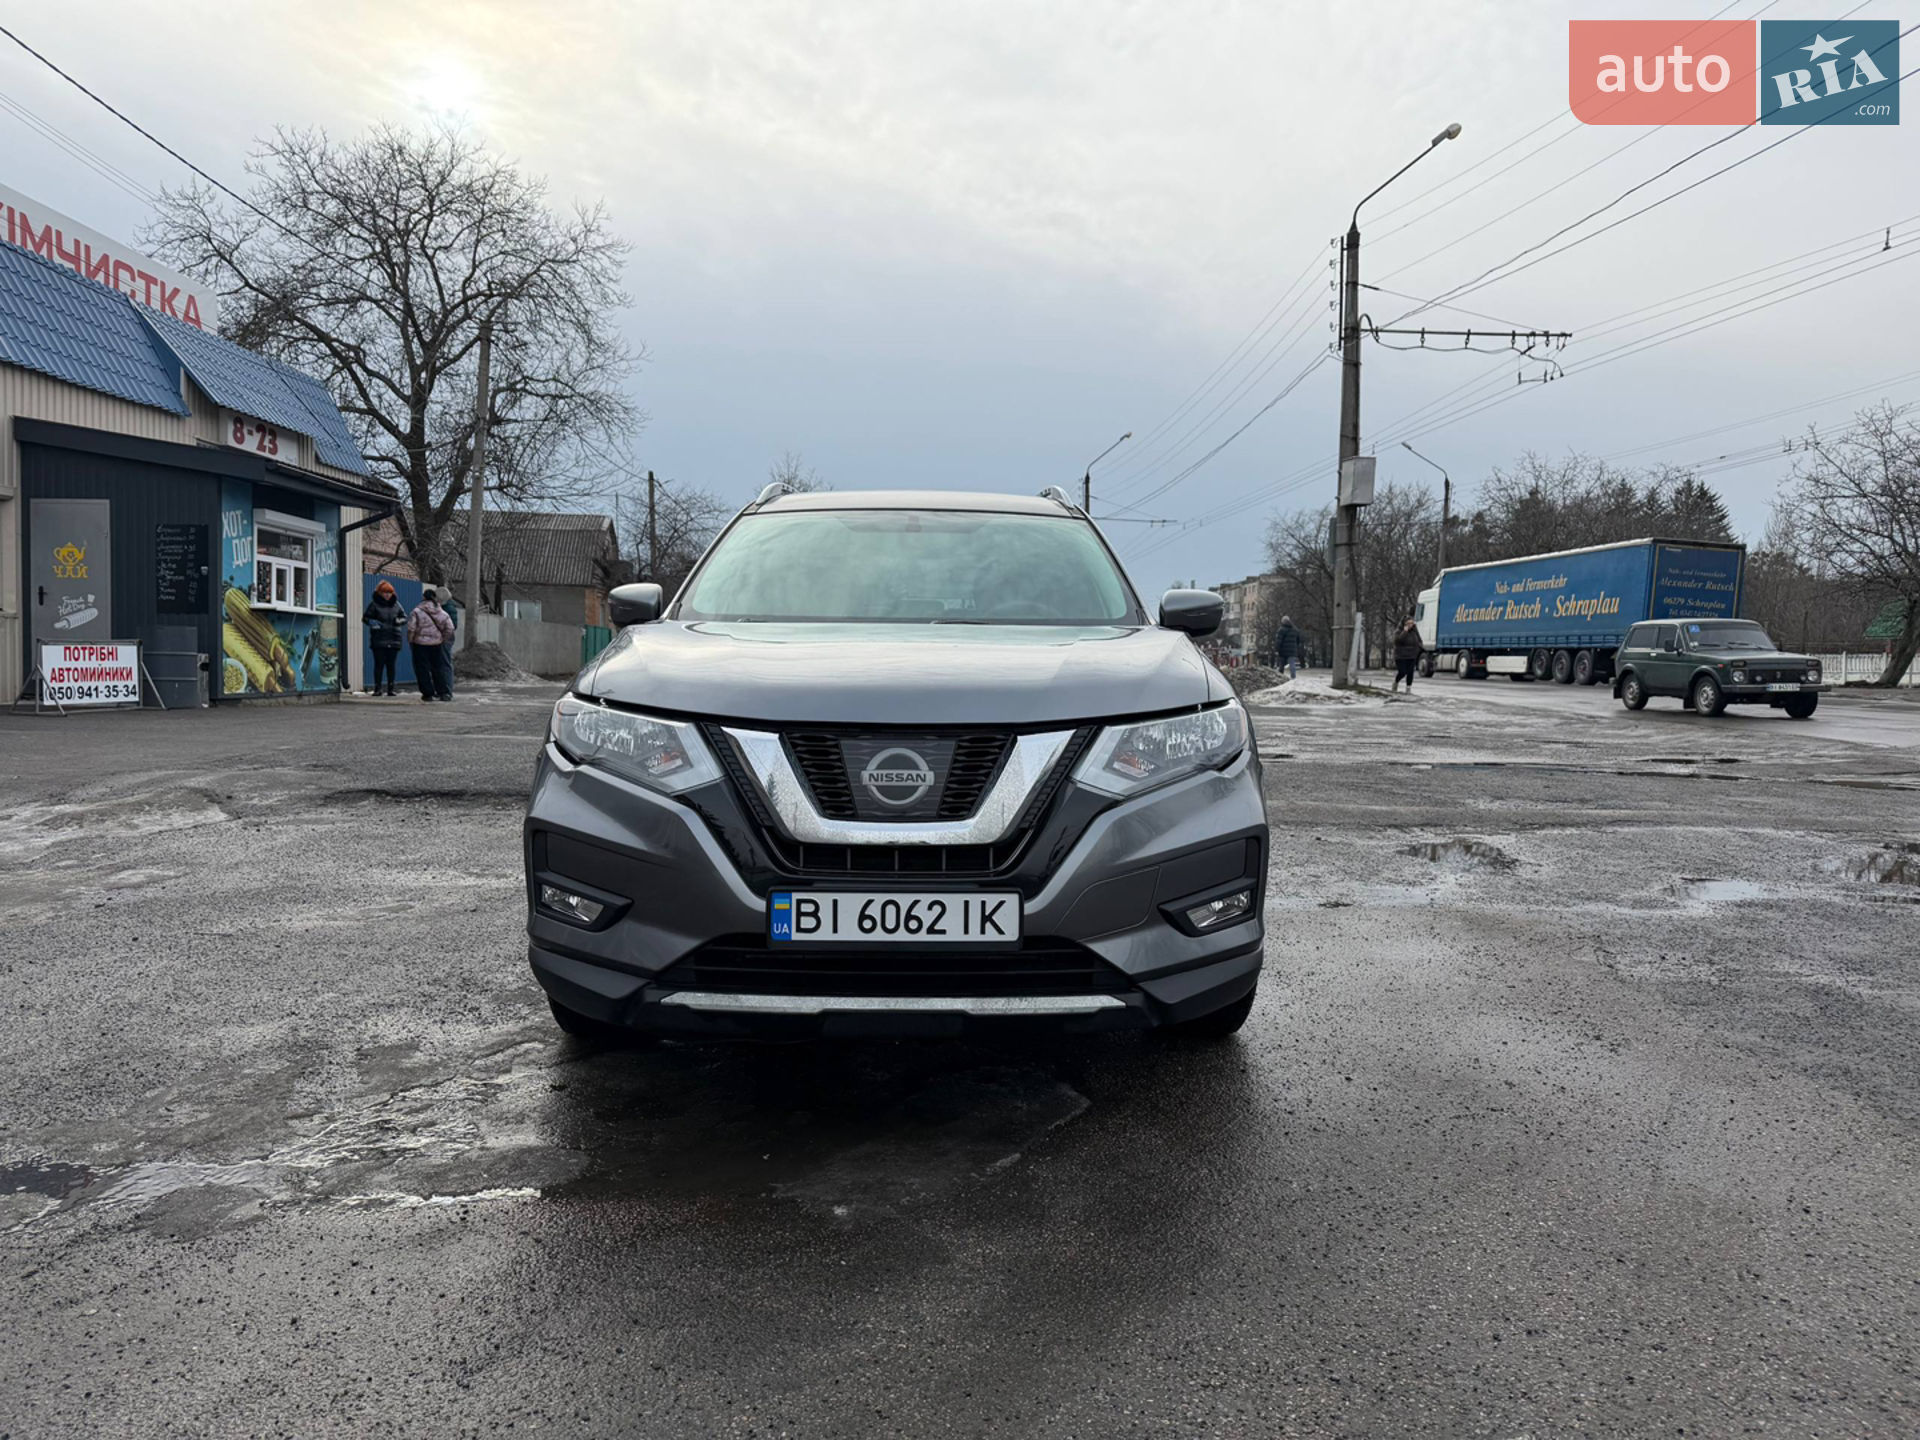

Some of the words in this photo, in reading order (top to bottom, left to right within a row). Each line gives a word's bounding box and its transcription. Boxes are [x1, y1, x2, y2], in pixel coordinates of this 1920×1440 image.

[232, 536, 252, 569] ДОГ
[52, 563, 88, 578] ЧАЙ
[315, 548, 338, 579] КАВА
[1512, 578, 1526, 593] und
[1525, 574, 1568, 591] Fernverkehr
[1657, 577, 1704, 589] Alexander
[1705, 580, 1735, 591] Rutsch
[1452, 601, 1504, 623] Alexander
[1504, 597, 1541, 620] Rutsch
[1553, 591, 1620, 621] Schraplau
[1686, 598, 1726, 609] Schraplau
[63, 646, 118, 662] ПОТРІБНІ
[50, 664, 133, 683] АВТОМИЙНИКИ
[868, 773, 926, 783] NISSAN
[795, 898, 838, 934] BI
[857, 898, 947, 935] 6062
[963, 899, 1006, 935] IK
[773, 923, 790, 934] UA
